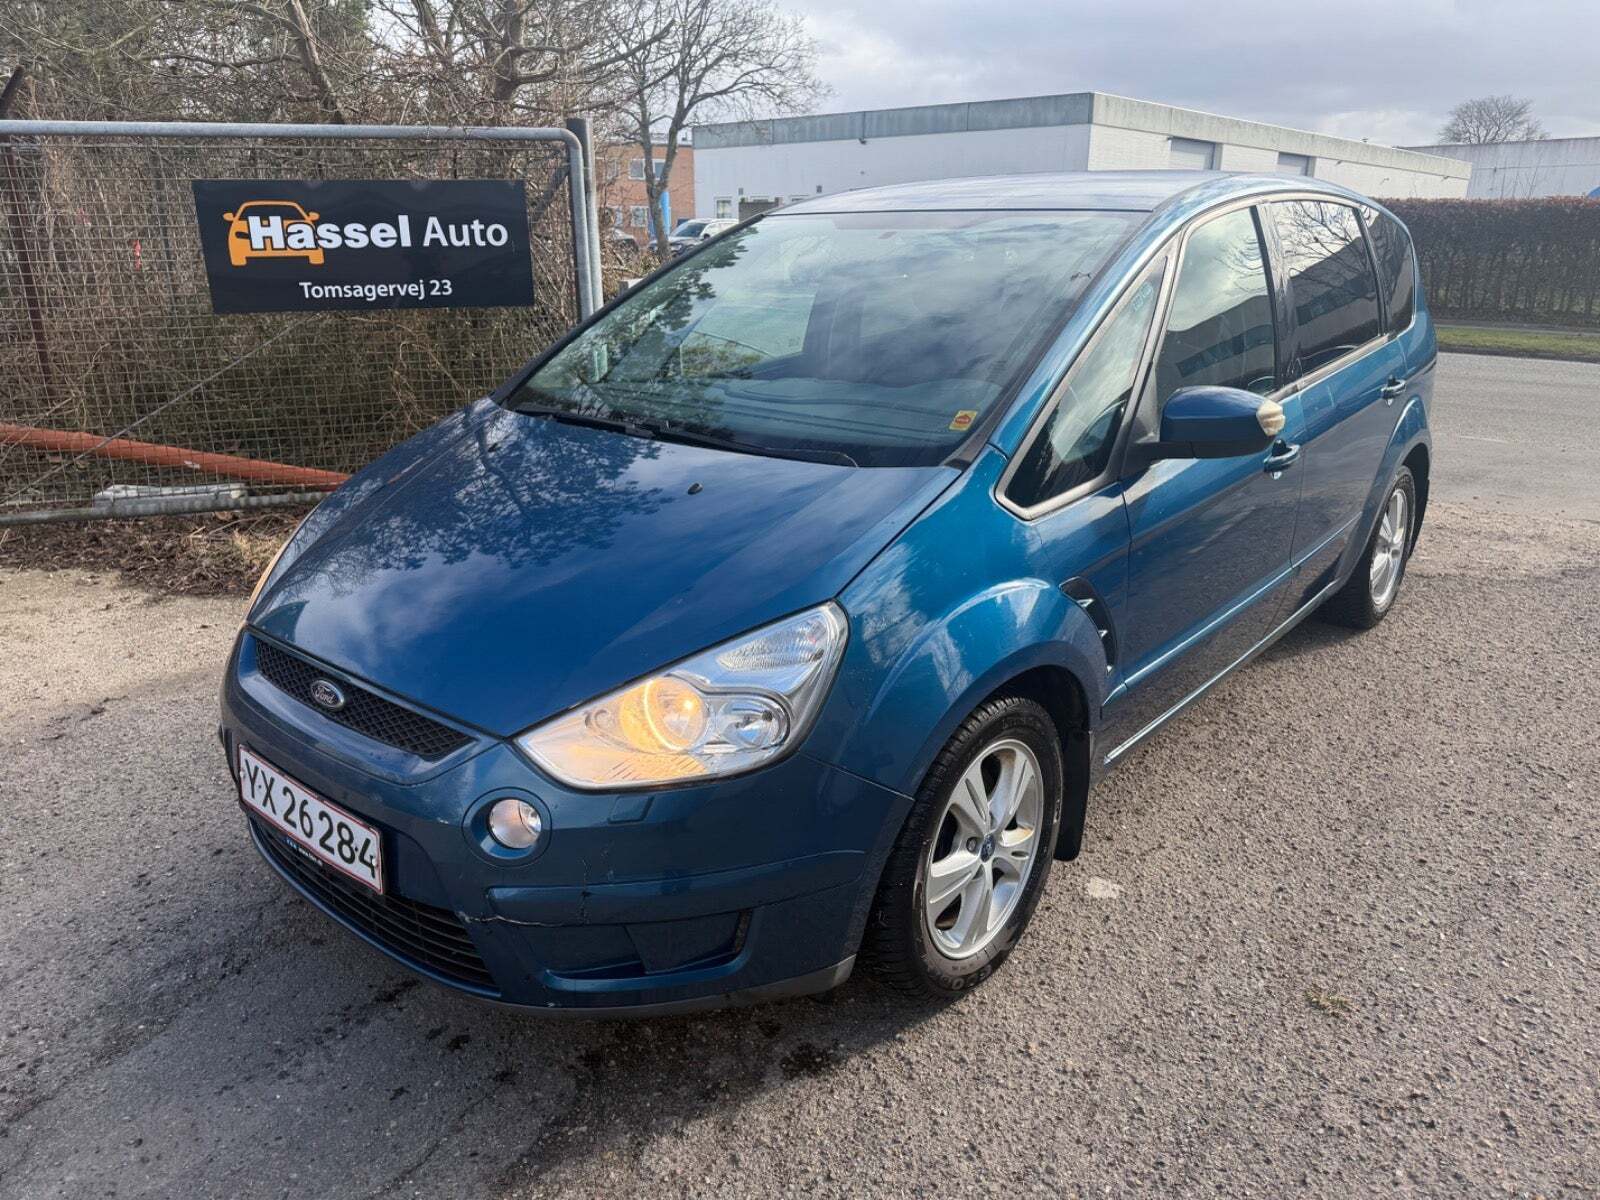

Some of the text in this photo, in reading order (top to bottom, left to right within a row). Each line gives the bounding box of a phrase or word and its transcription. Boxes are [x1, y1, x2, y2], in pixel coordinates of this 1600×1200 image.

[248, 214, 508, 250] Hassel Auto
[299, 279, 453, 301] Tomsagervej 23
[314, 684, 336, 704] Ford
